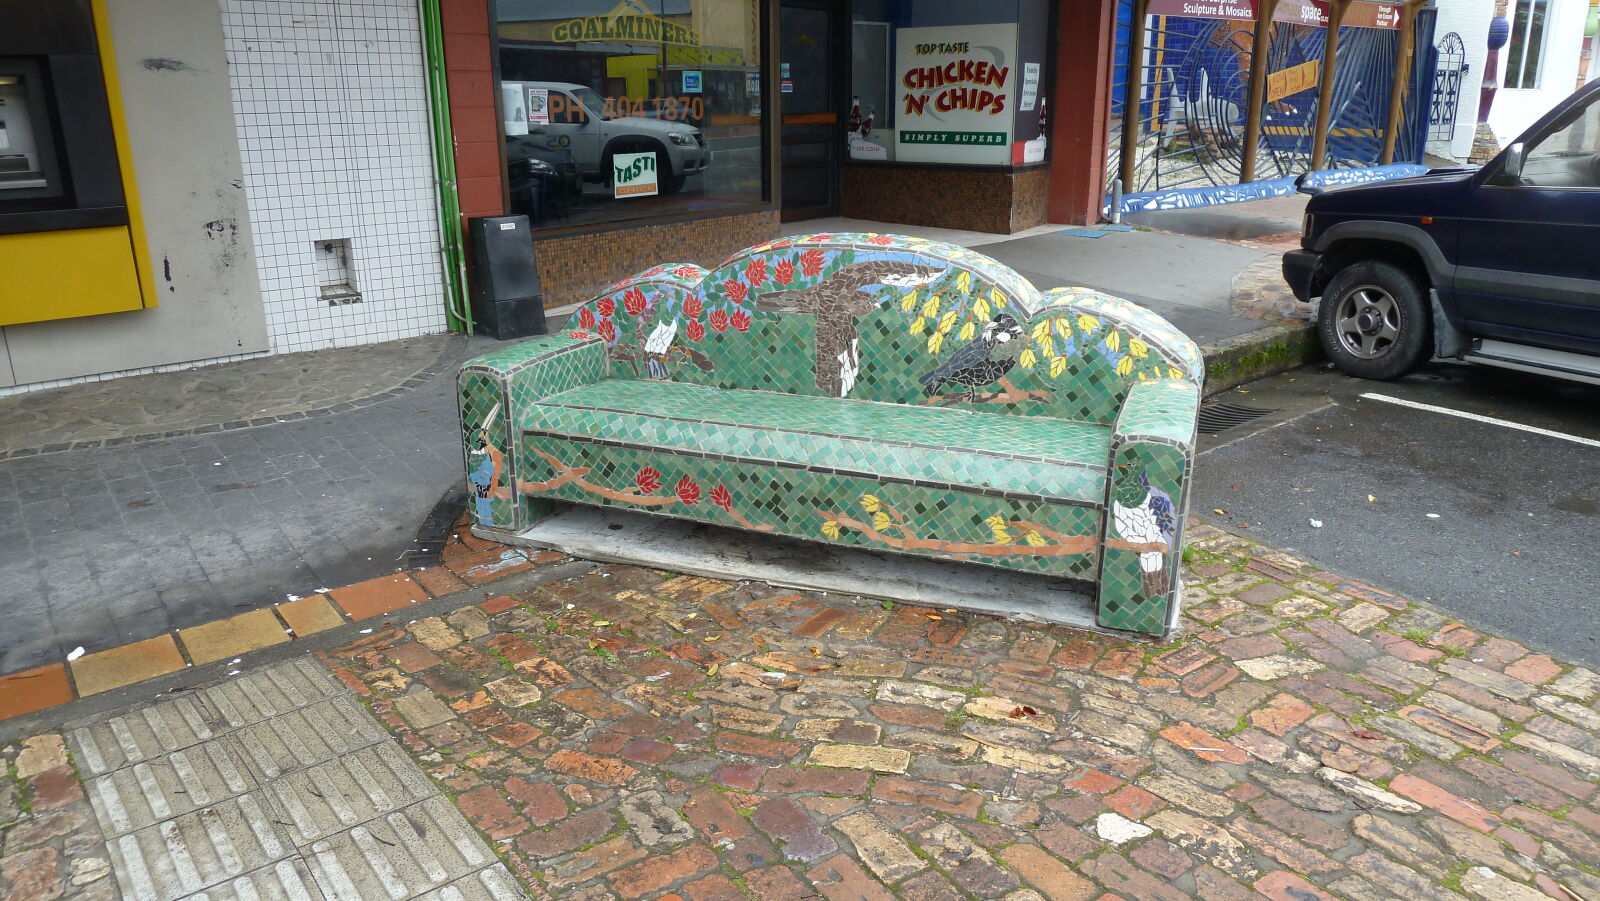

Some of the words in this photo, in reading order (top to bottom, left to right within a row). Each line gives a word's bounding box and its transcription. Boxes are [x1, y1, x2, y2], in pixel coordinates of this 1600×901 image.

[1183, 3, 1217, 16] Sculpture
[1218, 5, 1225, 16] &
[1225, 6, 1253, 17] Mosaics
[552, 15, 701, 46] COALMINERS
[914, 43, 937, 55] TOP
[937, 42, 970, 54] TASTE
[903, 60, 1009, 89] CHICKEN
[550, 95, 585, 123] PH
[601, 96, 645, 121] 404
[651, 96, 705, 121] 1870
[935, 87, 1006, 116] CHIPS
[904, 133, 949, 142] SIMPLY
[954, 134, 1002, 143] SUPERB
[614, 156, 656, 184] TASTI
